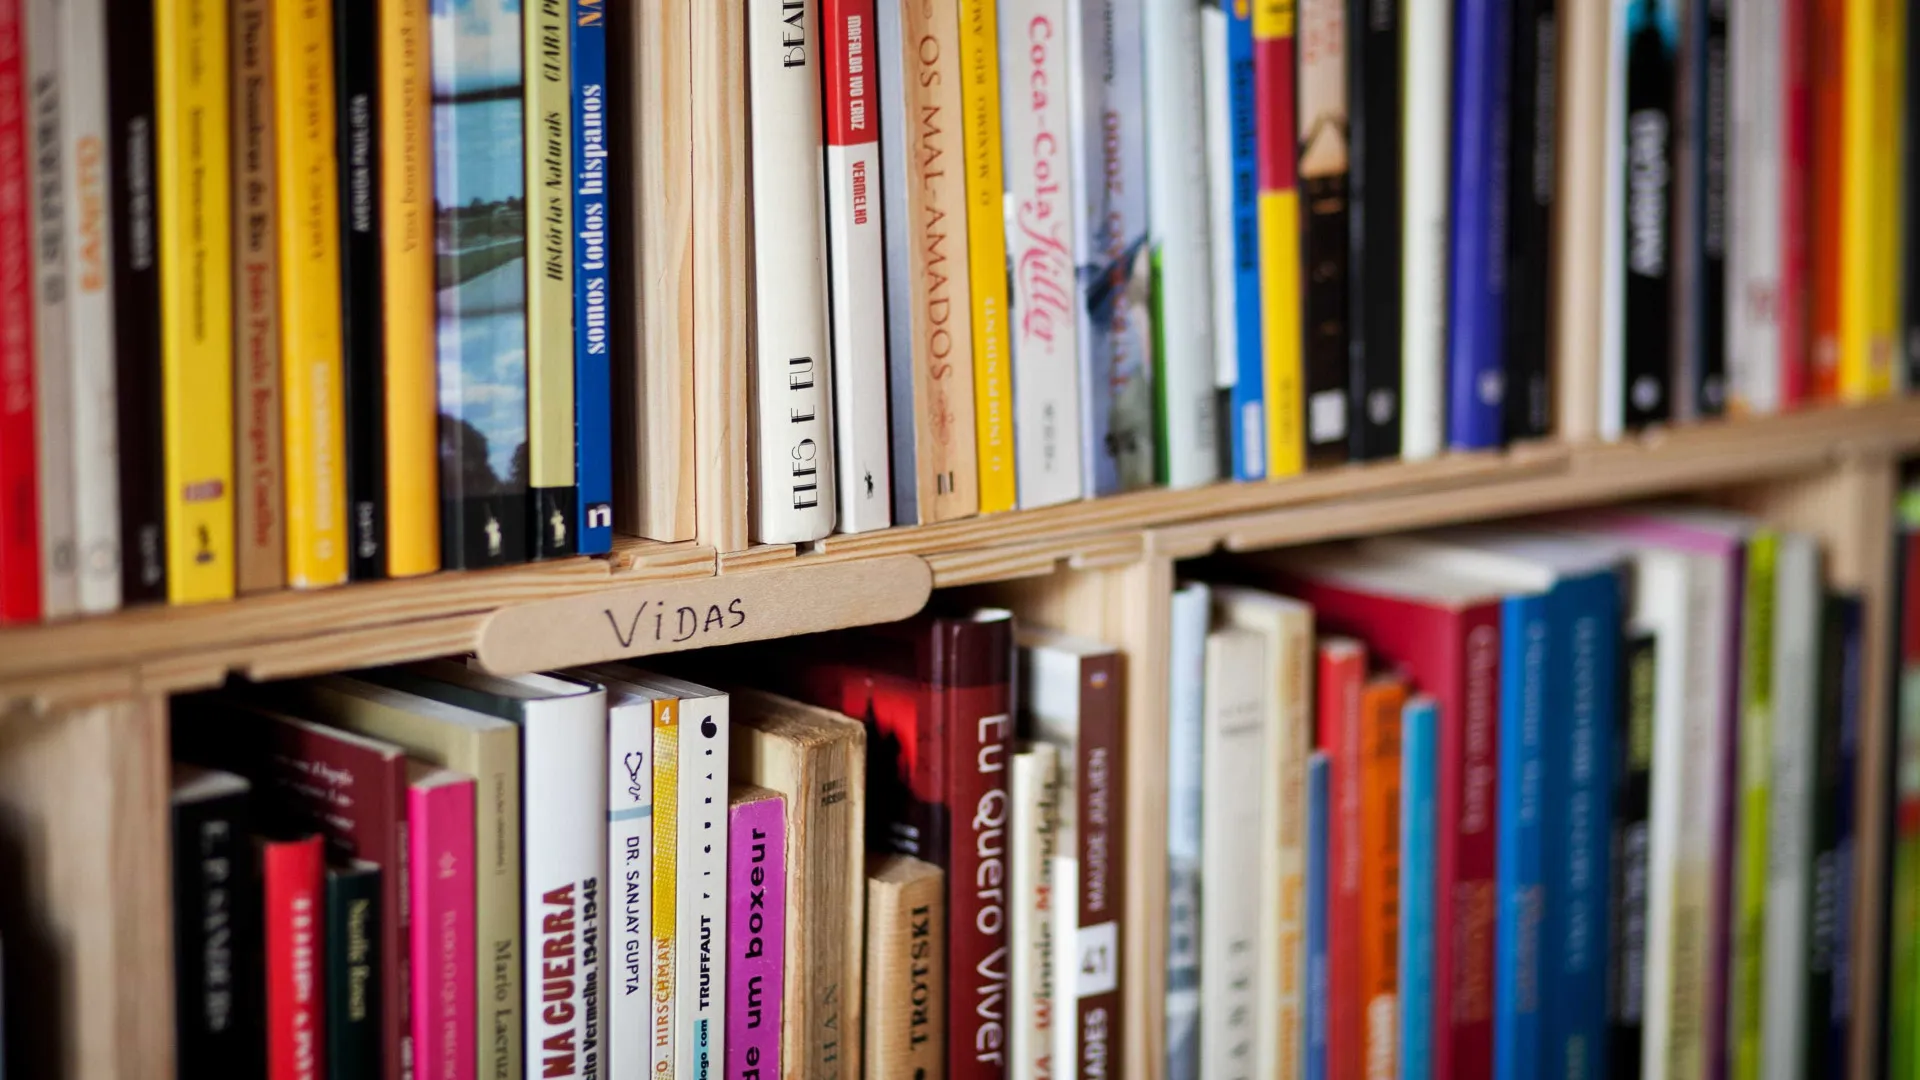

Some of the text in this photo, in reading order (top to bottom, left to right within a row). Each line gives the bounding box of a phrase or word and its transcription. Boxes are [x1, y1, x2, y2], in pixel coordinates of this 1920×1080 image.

[543, 24, 561, 82] CLARA
[847, 15, 865, 131] MAFALDA IVO CRUZ
[1029, 15, 1059, 220] Coca-Cola
[543, 111, 563, 281] Histórias Naturais
[579, 84, 608, 354] somos todos hispanos
[852, 160, 868, 226] VERMELHO
[919, 35, 953, 381] OS MAL-AMADOS
[789, 356, 817, 510] ELES E EU
[661, 707, 671, 724] 4
[745, 828, 767, 958] boxeur
[973, 714, 1008, 1065] Eu Quero Viver
[1089, 748, 1107, 910] MAUDE JULIEN
[494, 940, 511, 1001] Mario
[543, 882, 576, 1079] NA GUERRA
[583, 877, 598, 965] 1941-1945
[626, 836, 640, 996] DR. SANJAY GUPTA
[700, 915, 711, 1010] TRUFFAUT
[910, 904, 930, 1050] TROTSKI
[583, 967, 599, 1051] Vermelho,
[656, 937, 670, 1073] O. HIRSCHMAN
[699, 1019, 708, 1047] com
[747, 976, 764, 1029] um
